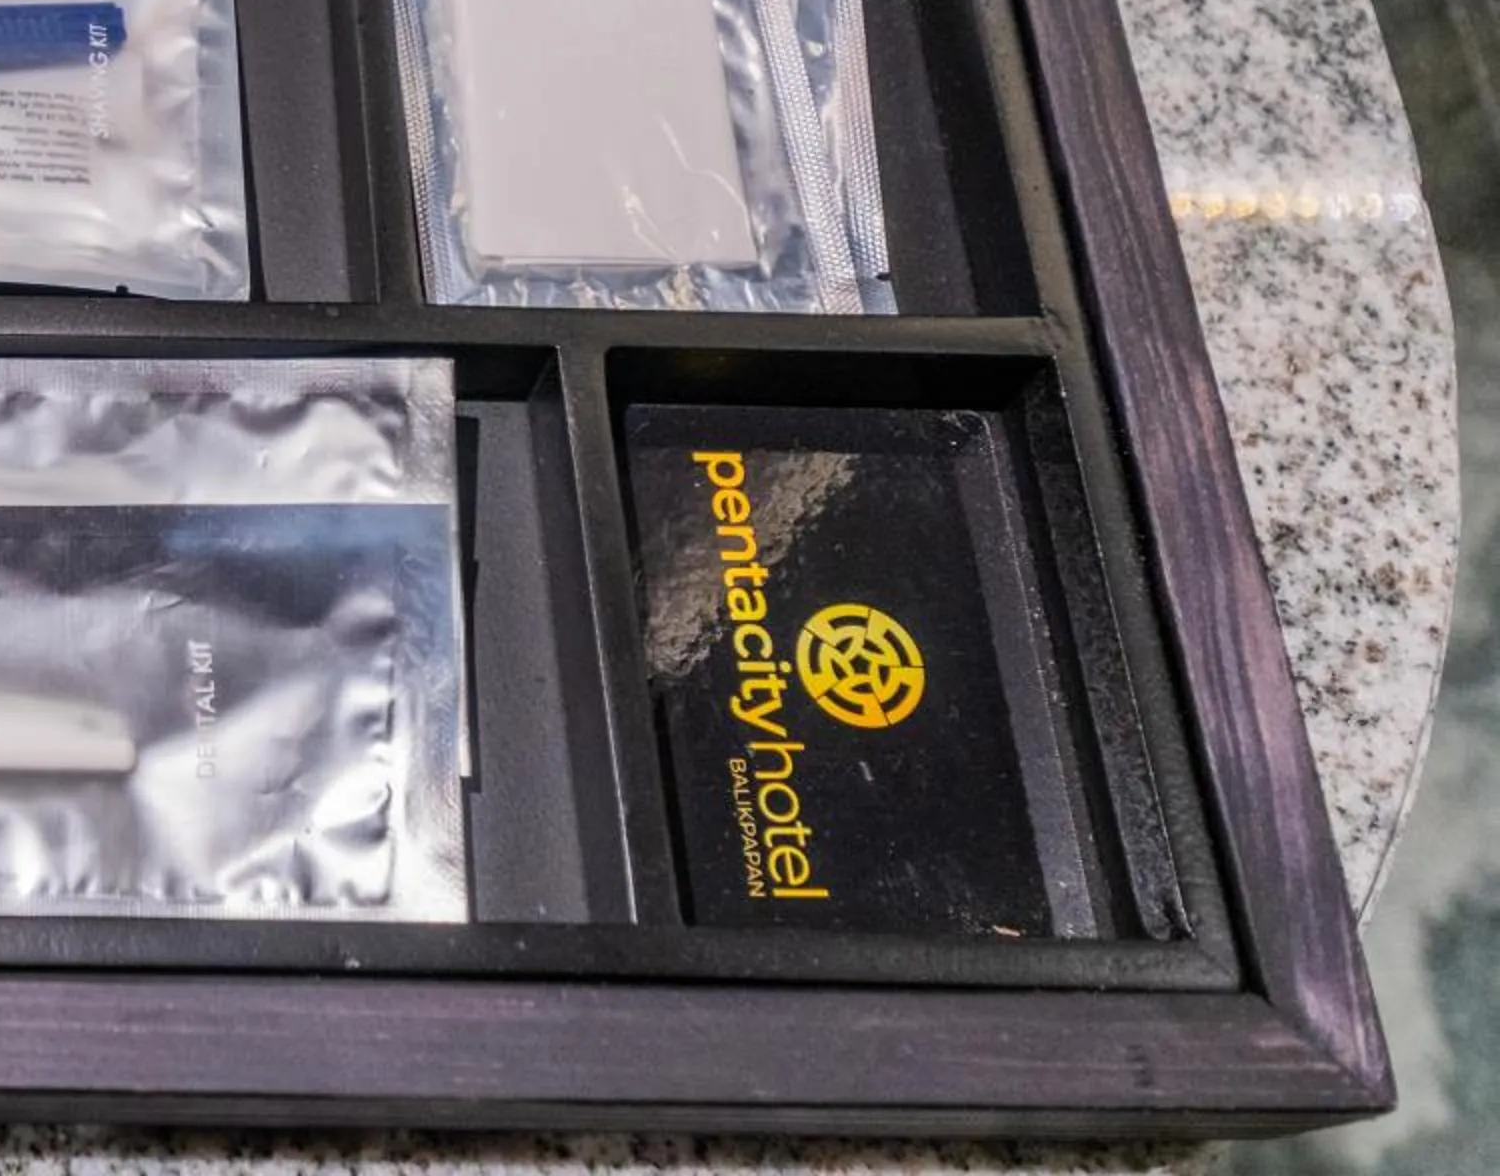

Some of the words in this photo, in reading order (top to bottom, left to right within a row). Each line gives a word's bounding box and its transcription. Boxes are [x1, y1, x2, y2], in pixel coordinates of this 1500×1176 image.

[87, 22, 108, 49] KIT
[186, 639, 213, 674] KIT
[194, 679, 217, 780] DETAL
[728, 757, 767, 899] BALIKPAPAN
